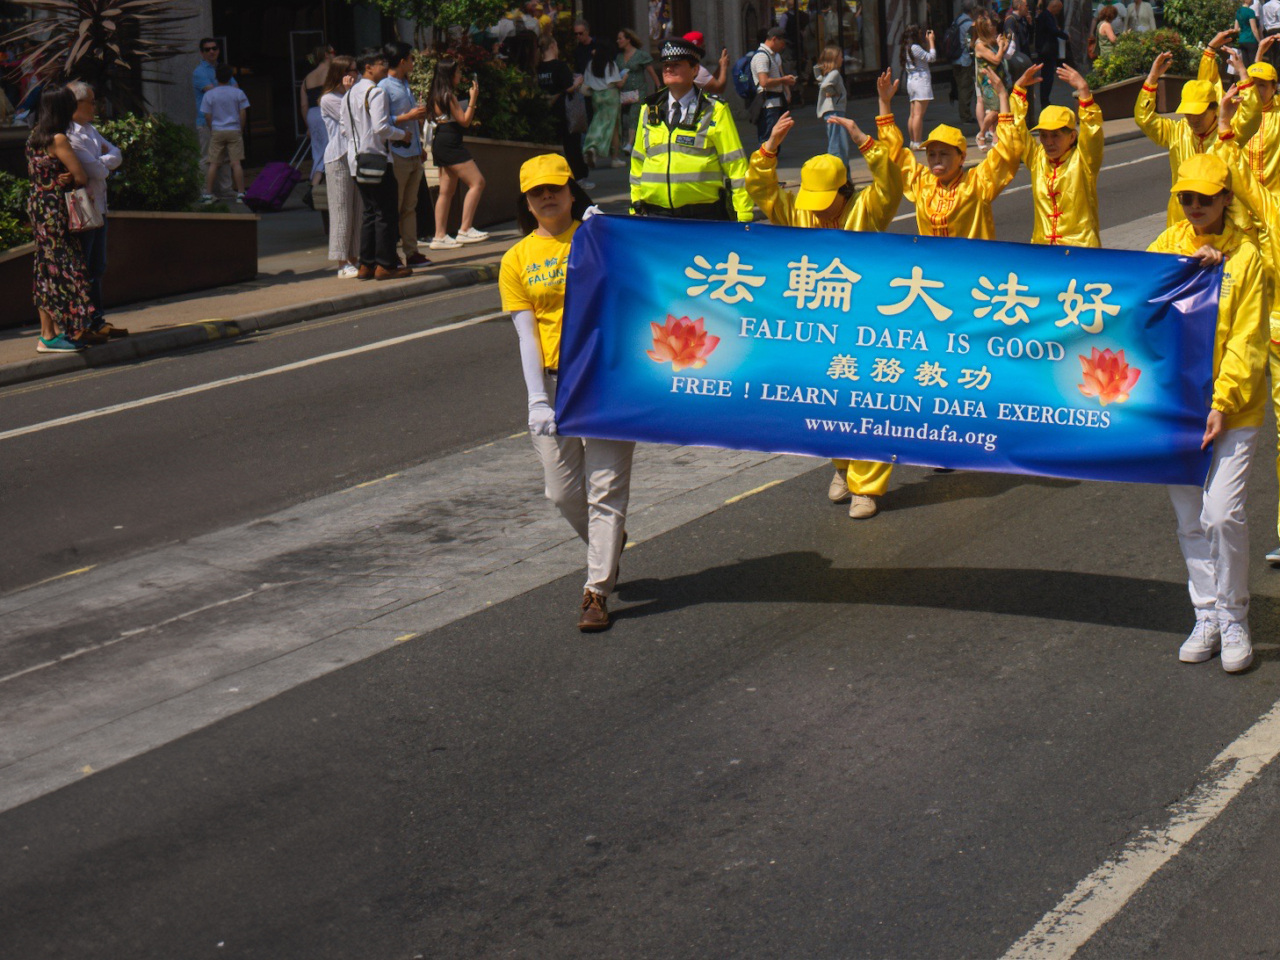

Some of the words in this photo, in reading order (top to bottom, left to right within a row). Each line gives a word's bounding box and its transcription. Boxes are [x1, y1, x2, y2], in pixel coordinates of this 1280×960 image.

[529, 268, 564, 286] FALUN
[684, 251, 1121, 334] 法輪大法好
[738, 317, 838, 344] FALUN
[855, 326, 929, 352] DAFA
[946, 333, 970, 354] IS
[987, 336, 1065, 361] GOOD
[826, 353, 992, 390] 義務教功
[670, 376, 732, 397] FREE
[744, 382, 749, 398] !
[760, 383, 838, 406] LEARN
[849, 391, 923, 413] FALUN
[933, 398, 987, 418] DAFA
[997, 403, 1111, 428] EXERCISES
[805, 418, 997, 451] www.Falundafa.org
